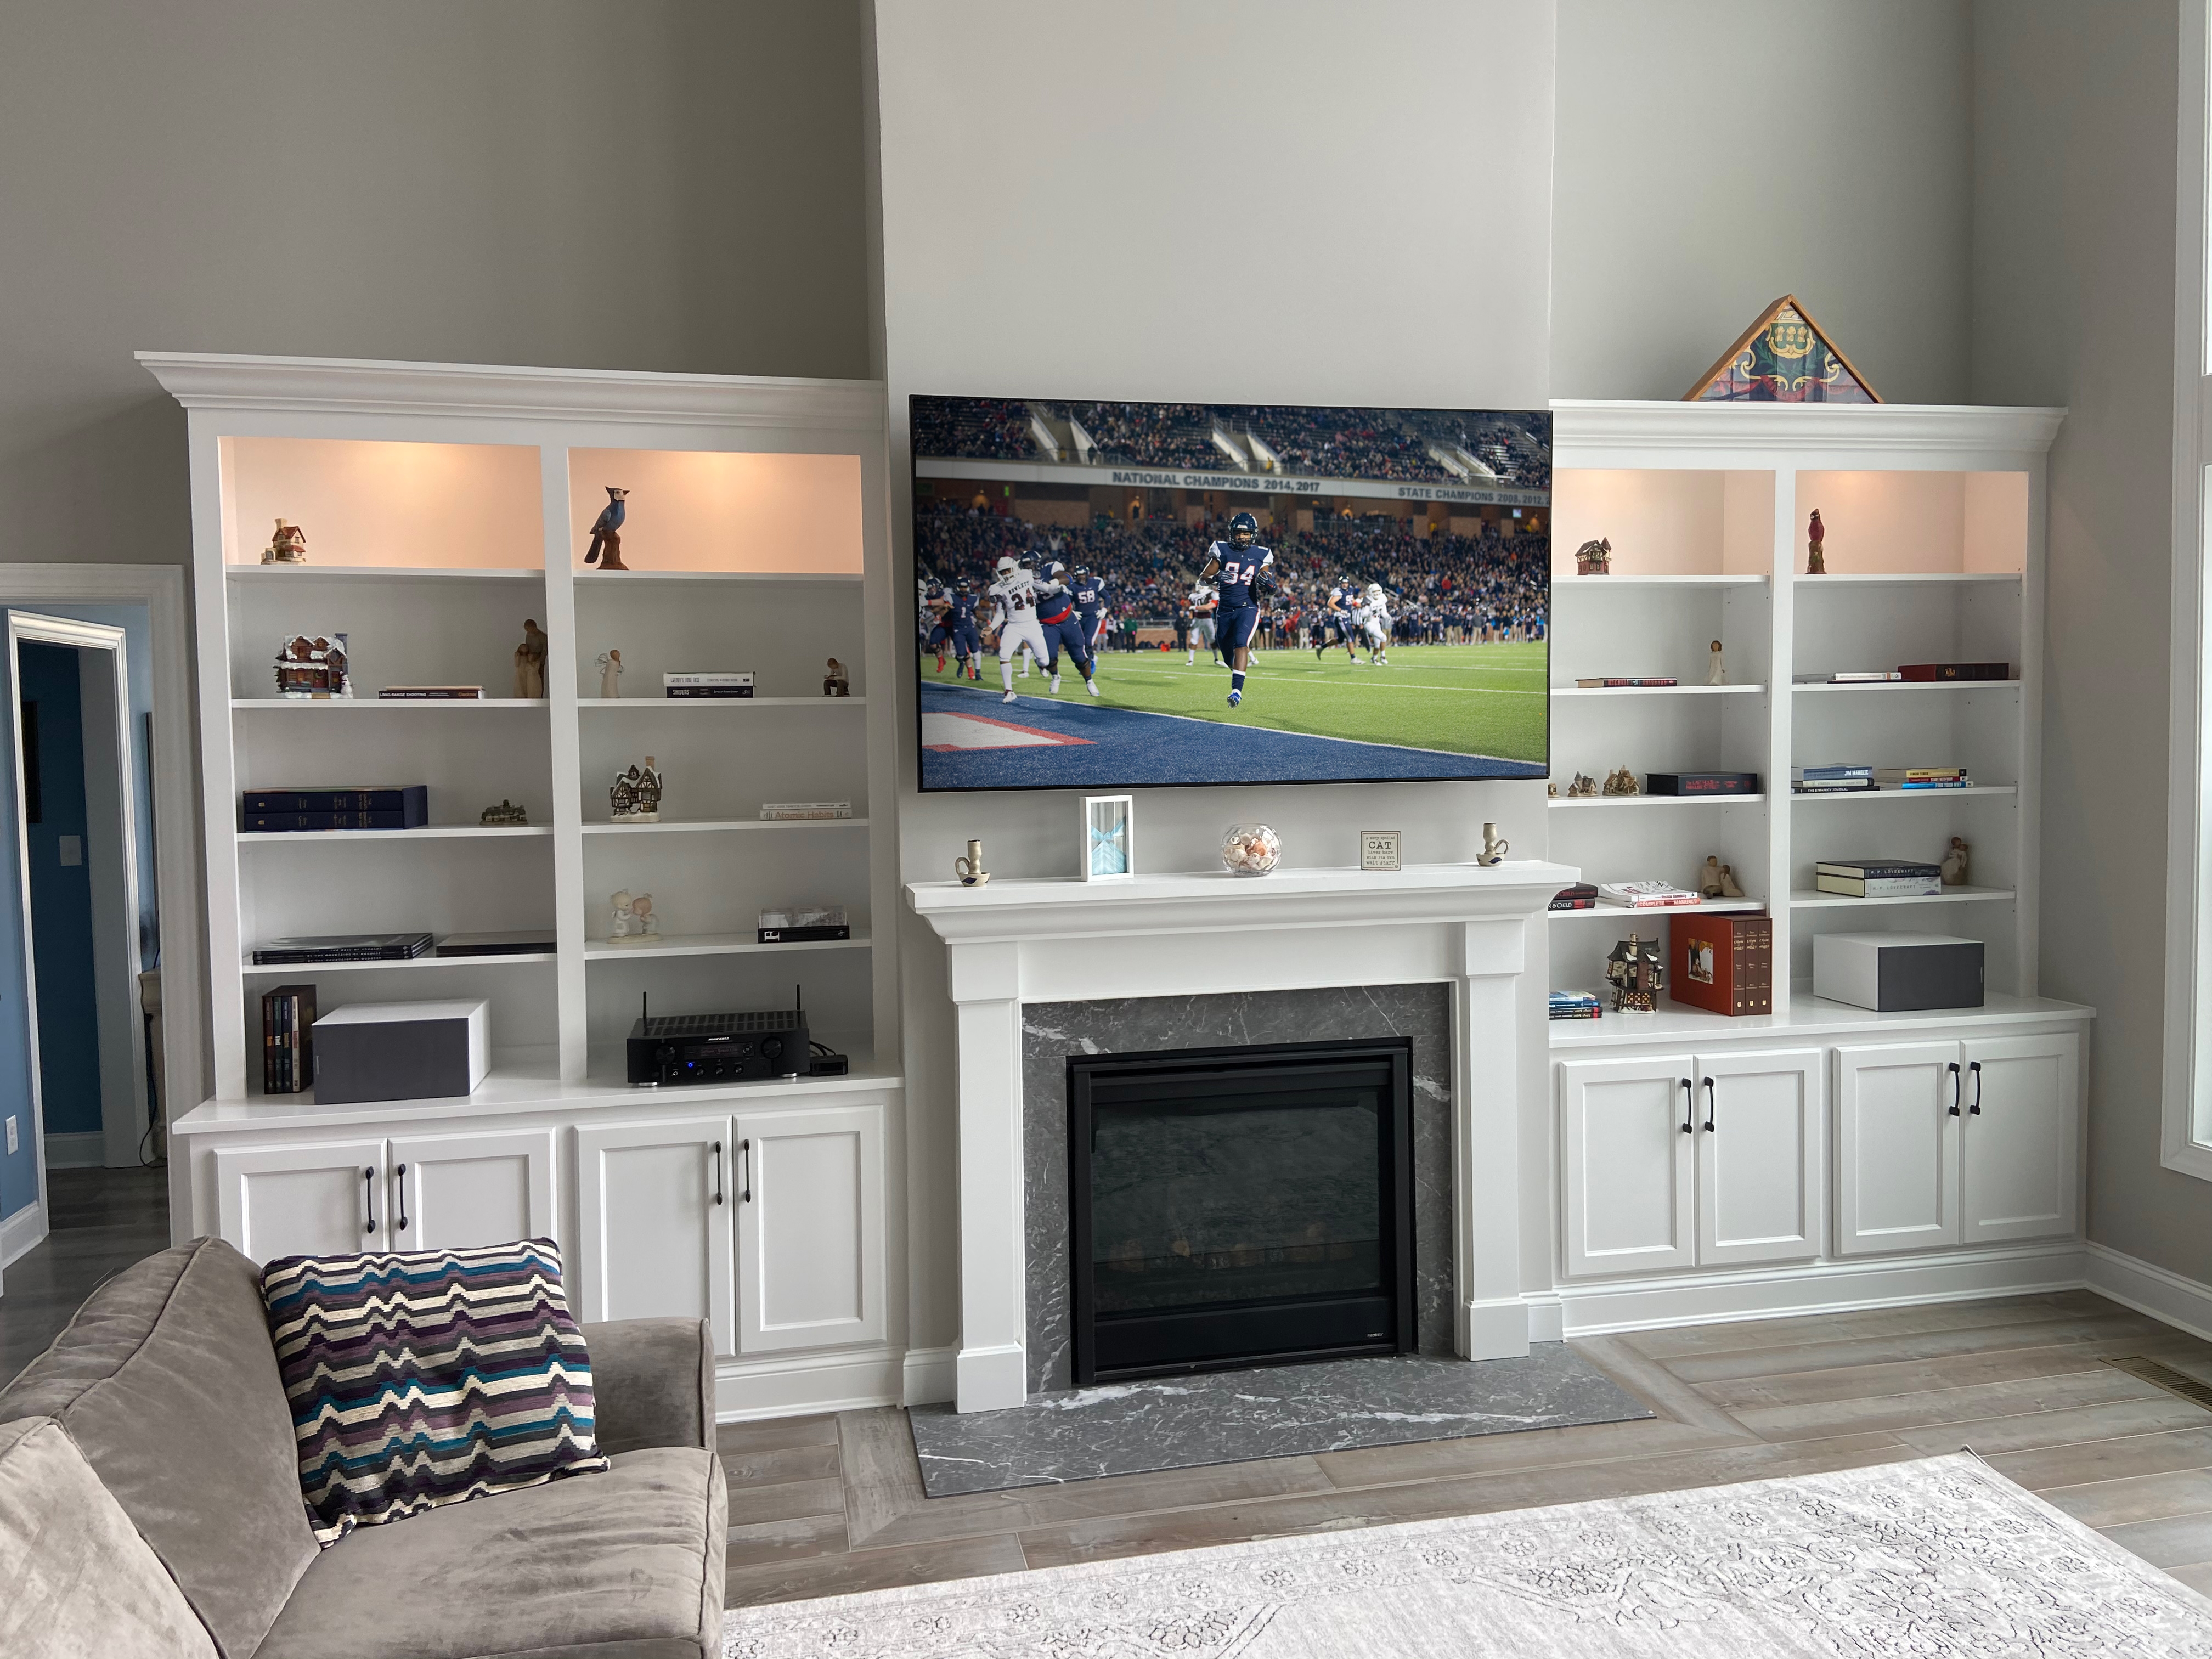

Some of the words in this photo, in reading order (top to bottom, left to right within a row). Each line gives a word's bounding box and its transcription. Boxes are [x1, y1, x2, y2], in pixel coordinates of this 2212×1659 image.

[1112, 472, 1180, 485] NATIONAL
[1183, 475, 1260, 489] CHAMPIONS
[1263, 479, 1294, 492] 2014,
[1296, 481, 1321, 492] 2017
[1398, 487, 1432, 498] STATE
[1435, 489, 1494, 501] CHAMPIONS
[1008, 581, 1029, 594] ROWLETT
[1077, 590, 1096, 603] 58
[961, 606, 966, 618] 1
[1368, 841, 1392, 849] CAT
